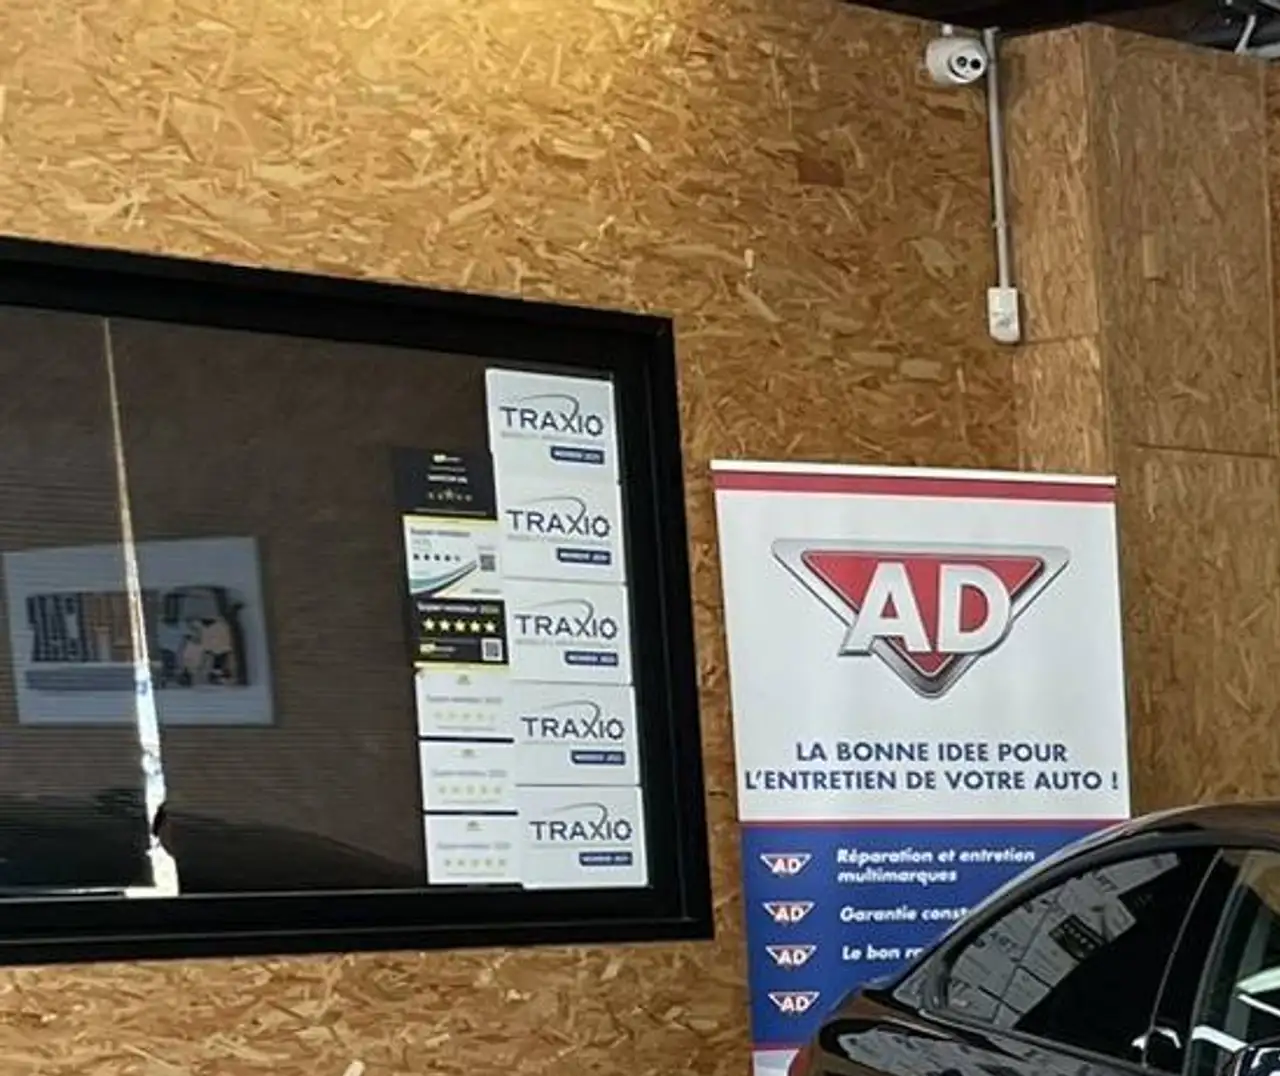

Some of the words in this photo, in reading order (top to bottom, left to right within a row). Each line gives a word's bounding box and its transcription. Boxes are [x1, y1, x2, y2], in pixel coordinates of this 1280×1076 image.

[500, 407, 603, 436] TRAXIO
[507, 510, 610, 537] TRAXIO
[840, 562, 1012, 656] AD
[515, 614, 617, 639] TRAXIO
[522, 717, 625, 740] TRAXIO
[796, 742, 826, 762] LA
[837, 743, 929, 763] BONNE
[939, 744, 989, 763] IDEE
[998, 744, 1068, 764] POUR
[746, 770, 897, 790] L'ENTRETIEN
[906, 771, 936, 790] DE
[946, 771, 1025, 791] VOTRE
[1035, 772, 1103, 791] AUTO
[1112, 772, 1119, 790] !
[530, 820, 633, 841] TRAXIO
[772, 858, 803, 874] AD
[837, 848, 933, 866] Réparation
[937, 851, 955, 863] et
[959, 850, 1035, 863] entretien
[837, 868, 957, 886] multimarques
[775, 907, 805, 922] AD
[840, 905, 917, 922] Garantie
[777, 949, 808, 965] AD
[842, 946, 862, 961] Le
[866, 945, 900, 961] bon
[781, 996, 811, 1012] AD
